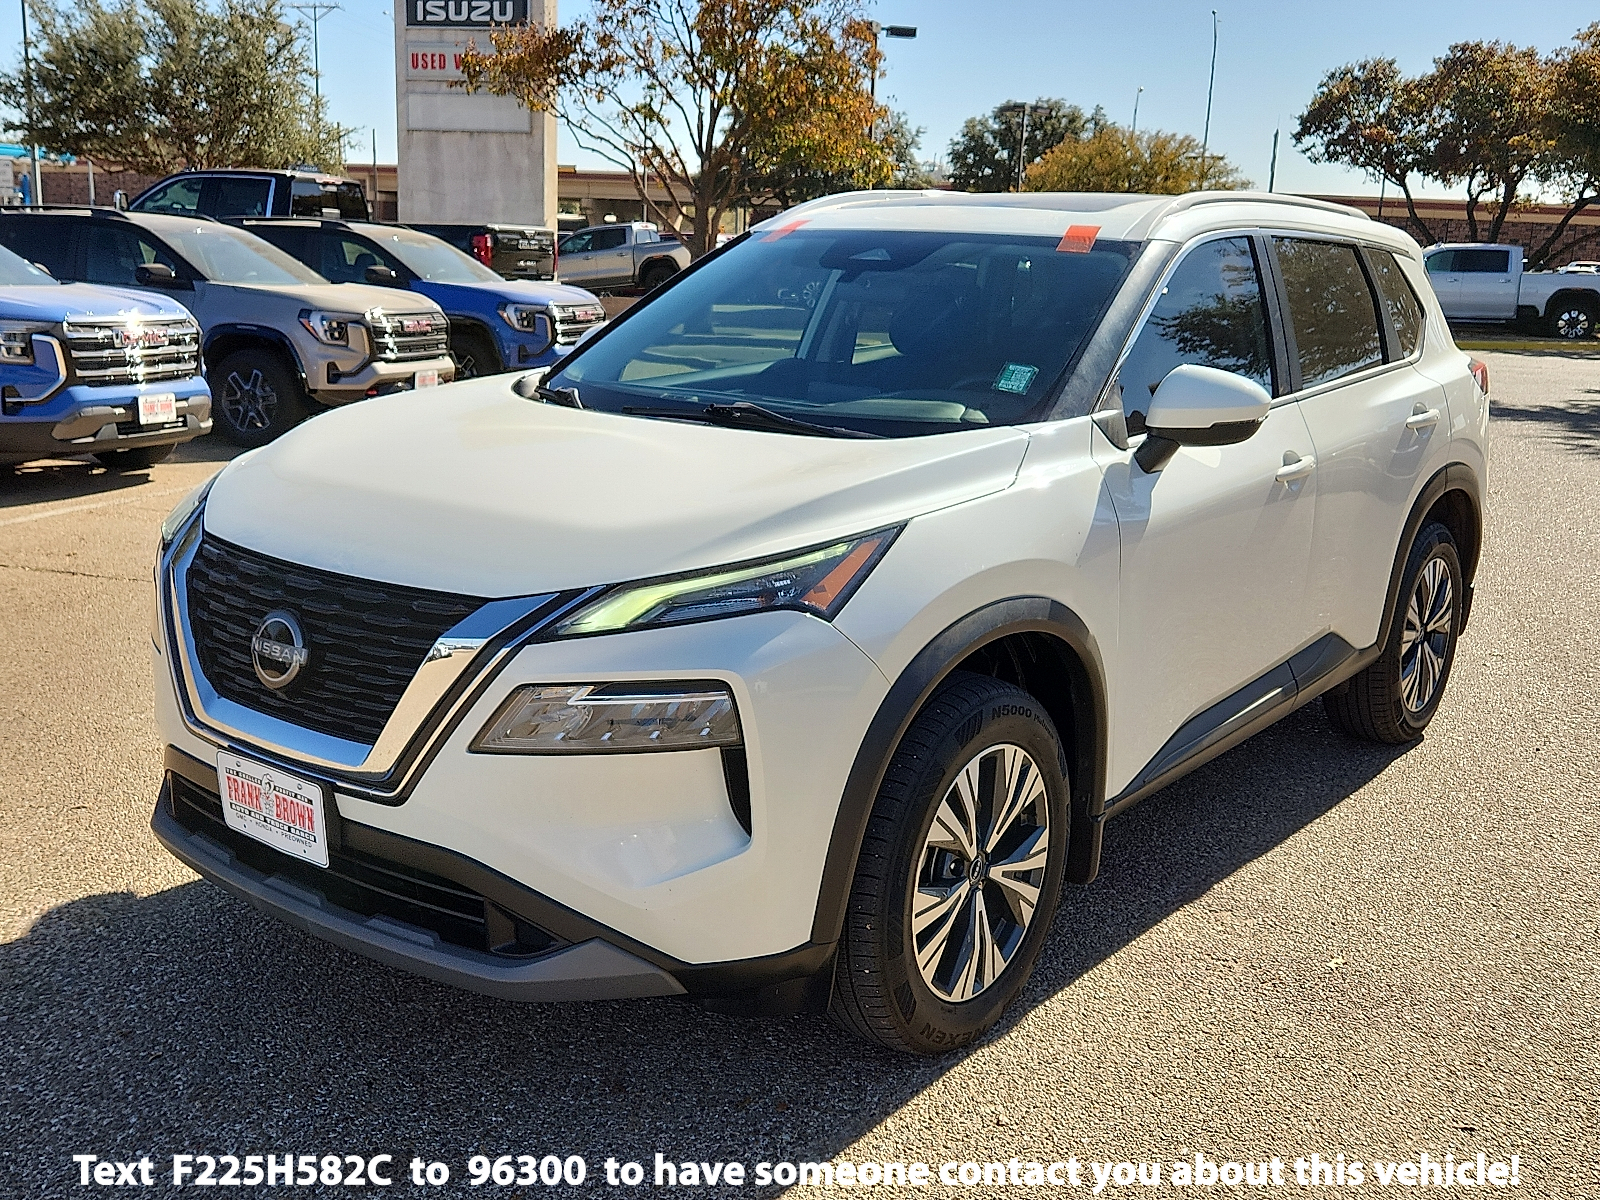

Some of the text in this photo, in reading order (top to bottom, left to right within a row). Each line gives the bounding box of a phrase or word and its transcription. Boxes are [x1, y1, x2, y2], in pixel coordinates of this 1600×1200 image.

[416, 0, 514, 22] ISUZU
[411, 52, 447, 70] USED
[253, 638, 305, 662] NISSAN
[991, 704, 1032, 720] N5000
[226, 775, 315, 833] FRANK BROWN
[231, 803, 316, 842] AUTO AND TRUCK RANCH
[235, 813, 313, 848] GMC HONDA PREOWNED
